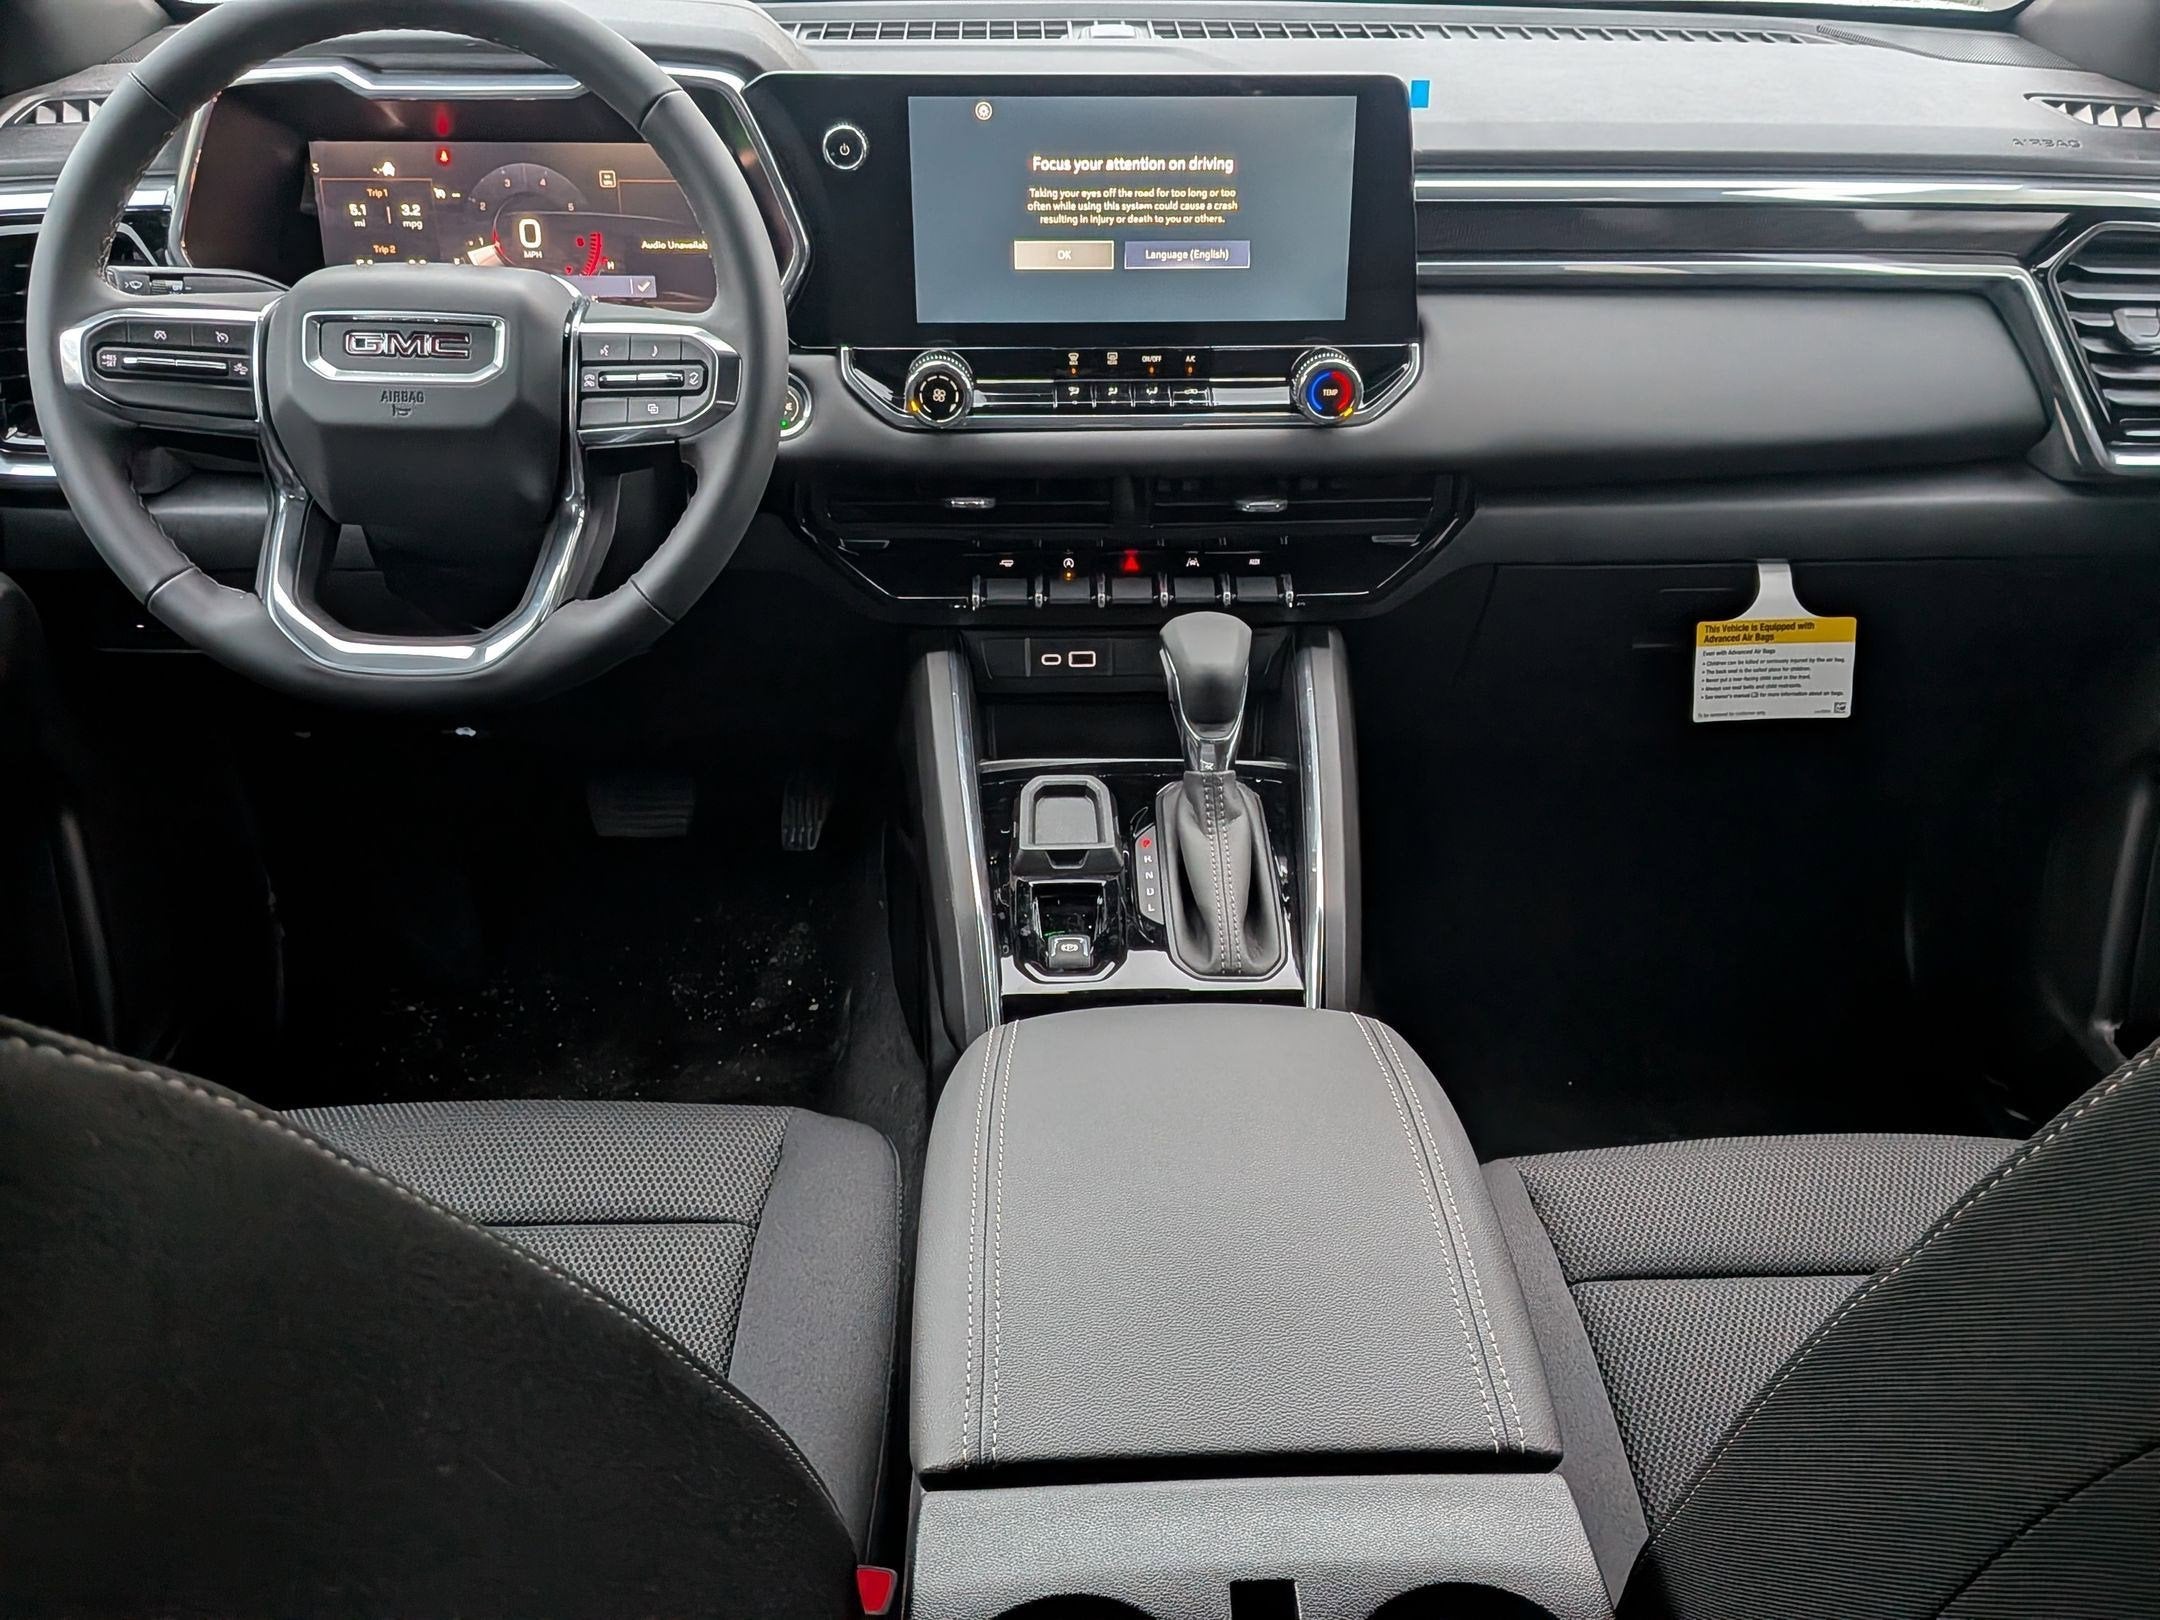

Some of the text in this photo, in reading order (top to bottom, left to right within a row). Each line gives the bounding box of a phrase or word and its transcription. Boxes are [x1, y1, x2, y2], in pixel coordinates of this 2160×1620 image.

[1032, 155, 1234, 175] Focus your attention on driving
[504, 179, 511, 188] 3
[540, 178, 546, 187] 4
[367, 188, 383, 198] Trip
[1029, 187, 1236, 200] Taking your eyes off the road for too long or too
[400, 203, 421, 217] 3.2
[480, 202, 487, 211] 2
[568, 202, 575, 211] 5
[1027, 200, 1238, 213] often while using this system could cause a crash
[354, 219, 366, 228] mi
[1040, 213, 1226, 226] resulting in injury or death to you or others.
[402, 220, 423, 230] mpg
[518, 218, 542, 249] 0
[373, 245, 396, 255] Trip 2
[641, 240, 666, 250] Audio
[523, 251, 543, 259] MPH
[1057, 249, 1072, 260] OK
[1145, 248, 1229, 261] Language (English)
[343, 329, 471, 359] GMC
[1142, 355, 1161, 363] ON/OFF
[1185, 355, 1196, 363] A/C
[380, 390, 425, 404] AIRBAG
[1322, 388, 1339, 396] TEMP
[1705, 621, 1815, 633] This Vehicle is Equipped with
[1704, 632, 1774, 643] Advanced Air Bags
[1145, 871, 1154, 880] N
[1146, 887, 1155, 896] D
[1147, 903, 1155, 912] L
